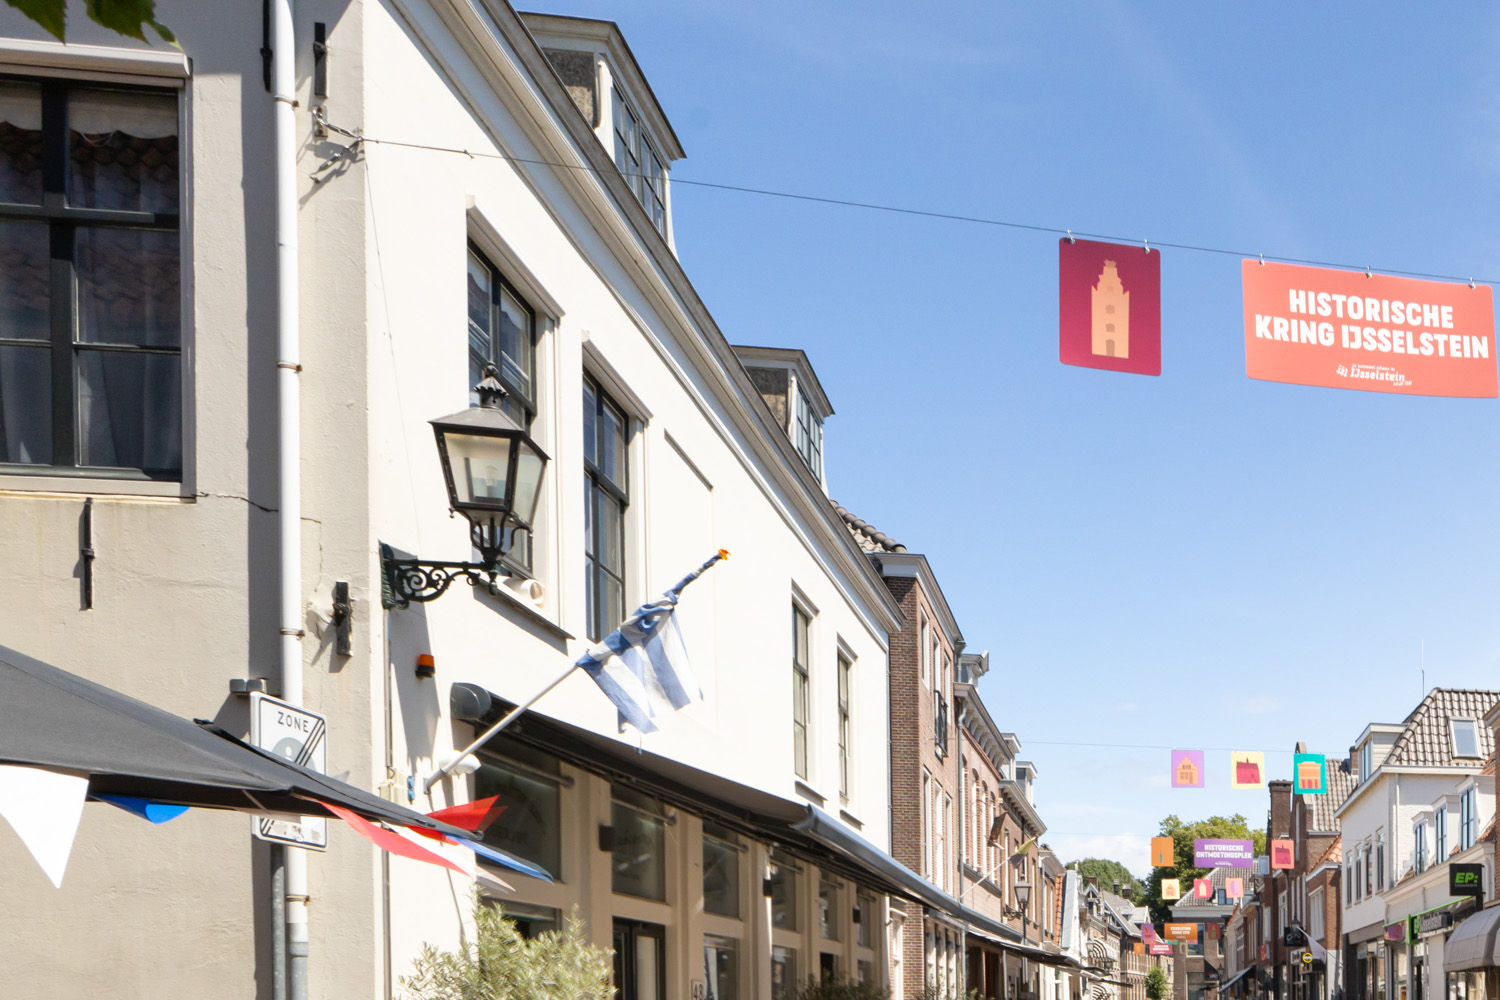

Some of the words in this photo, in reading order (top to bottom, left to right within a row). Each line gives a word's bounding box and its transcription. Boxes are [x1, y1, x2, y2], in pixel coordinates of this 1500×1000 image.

[1289, 289, 1454, 329] HISTORISCHE
[1255, 314, 1335, 347] KRING
[1341, 325, 1489, 359] IJSSELSTEIN
[1350, 367, 1406, 382] IJsselstein
[277, 711, 309, 733] ZONE
[1196, 851, 1252, 859] ONTMOETINGSPLEK
[1455, 872, 1479, 884] EP:
